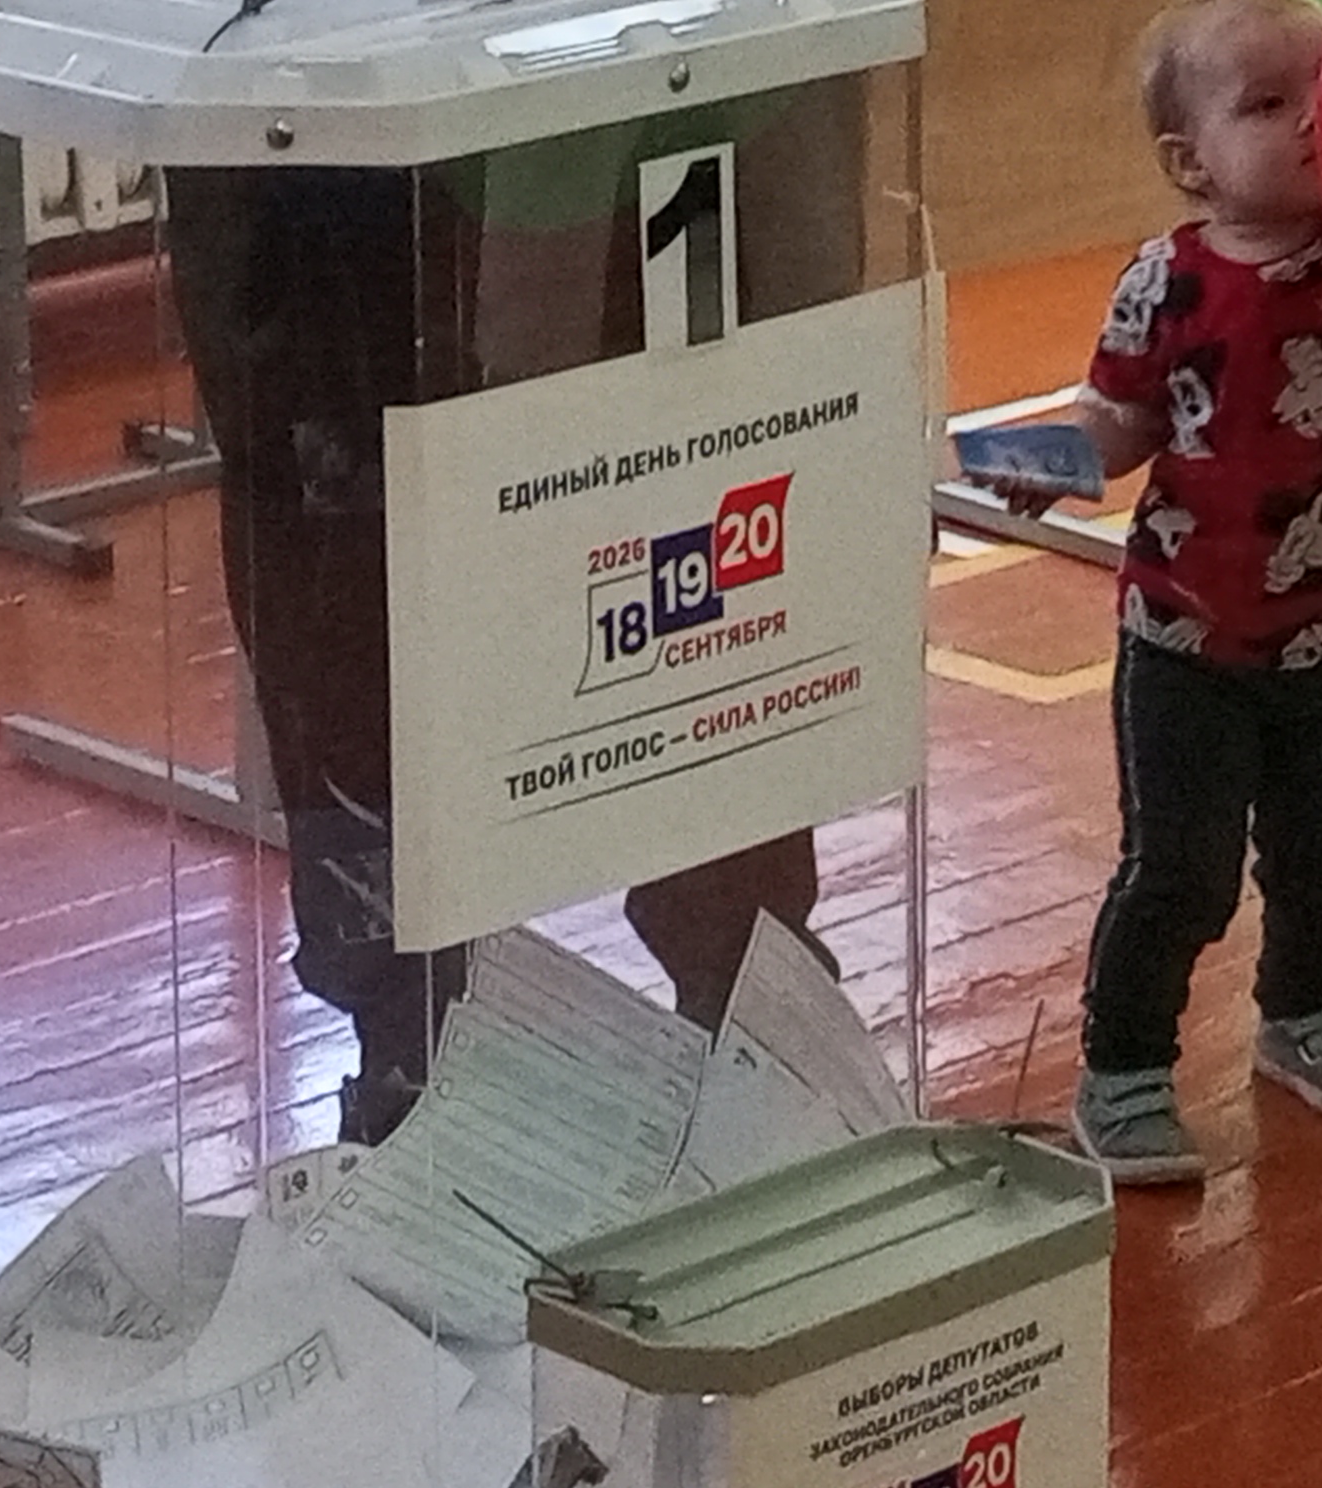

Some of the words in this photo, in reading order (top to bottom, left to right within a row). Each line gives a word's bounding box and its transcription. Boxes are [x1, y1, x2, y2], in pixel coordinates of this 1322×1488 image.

[646, 156, 725, 347] 1
[498, 454, 609, 513] ЕДИНЫЙ
[614, 443, 681, 486] ДЕНЬ
[686, 391, 860, 462] ГОЛОСОВАНИЯ
[588, 536, 646, 575] 2026
[596, 601, 648, 663] 18
[658, 550, 709, 615] 19
[719, 502, 779, 570] 20
[665, 609, 787, 669] СЕНТЯБРЯ
[506, 752, 575, 801] ТВОЙ
[581, 730, 665, 780] ГОЛОС
[692, 701, 757, 743] СИЛА
[763, 665, 861, 723] РОССИИ!
[809, 1377, 979, 1462] ЗАКОНОДАТЕЛЬНОГО
[982, 1341, 1065, 1391] СОБРАНИЯ
[838, 1364, 924, 1418] ВЫБОРЫ
[928, 1320, 1039, 1387] ДЕПУТАТОВ
[839, 1400, 965, 1468] ОРЕНБУРГСКОЙ
[968, 1373, 1041, 1416] ОБЛАСТИ
[963, 1442, 1012, 1488] 20
